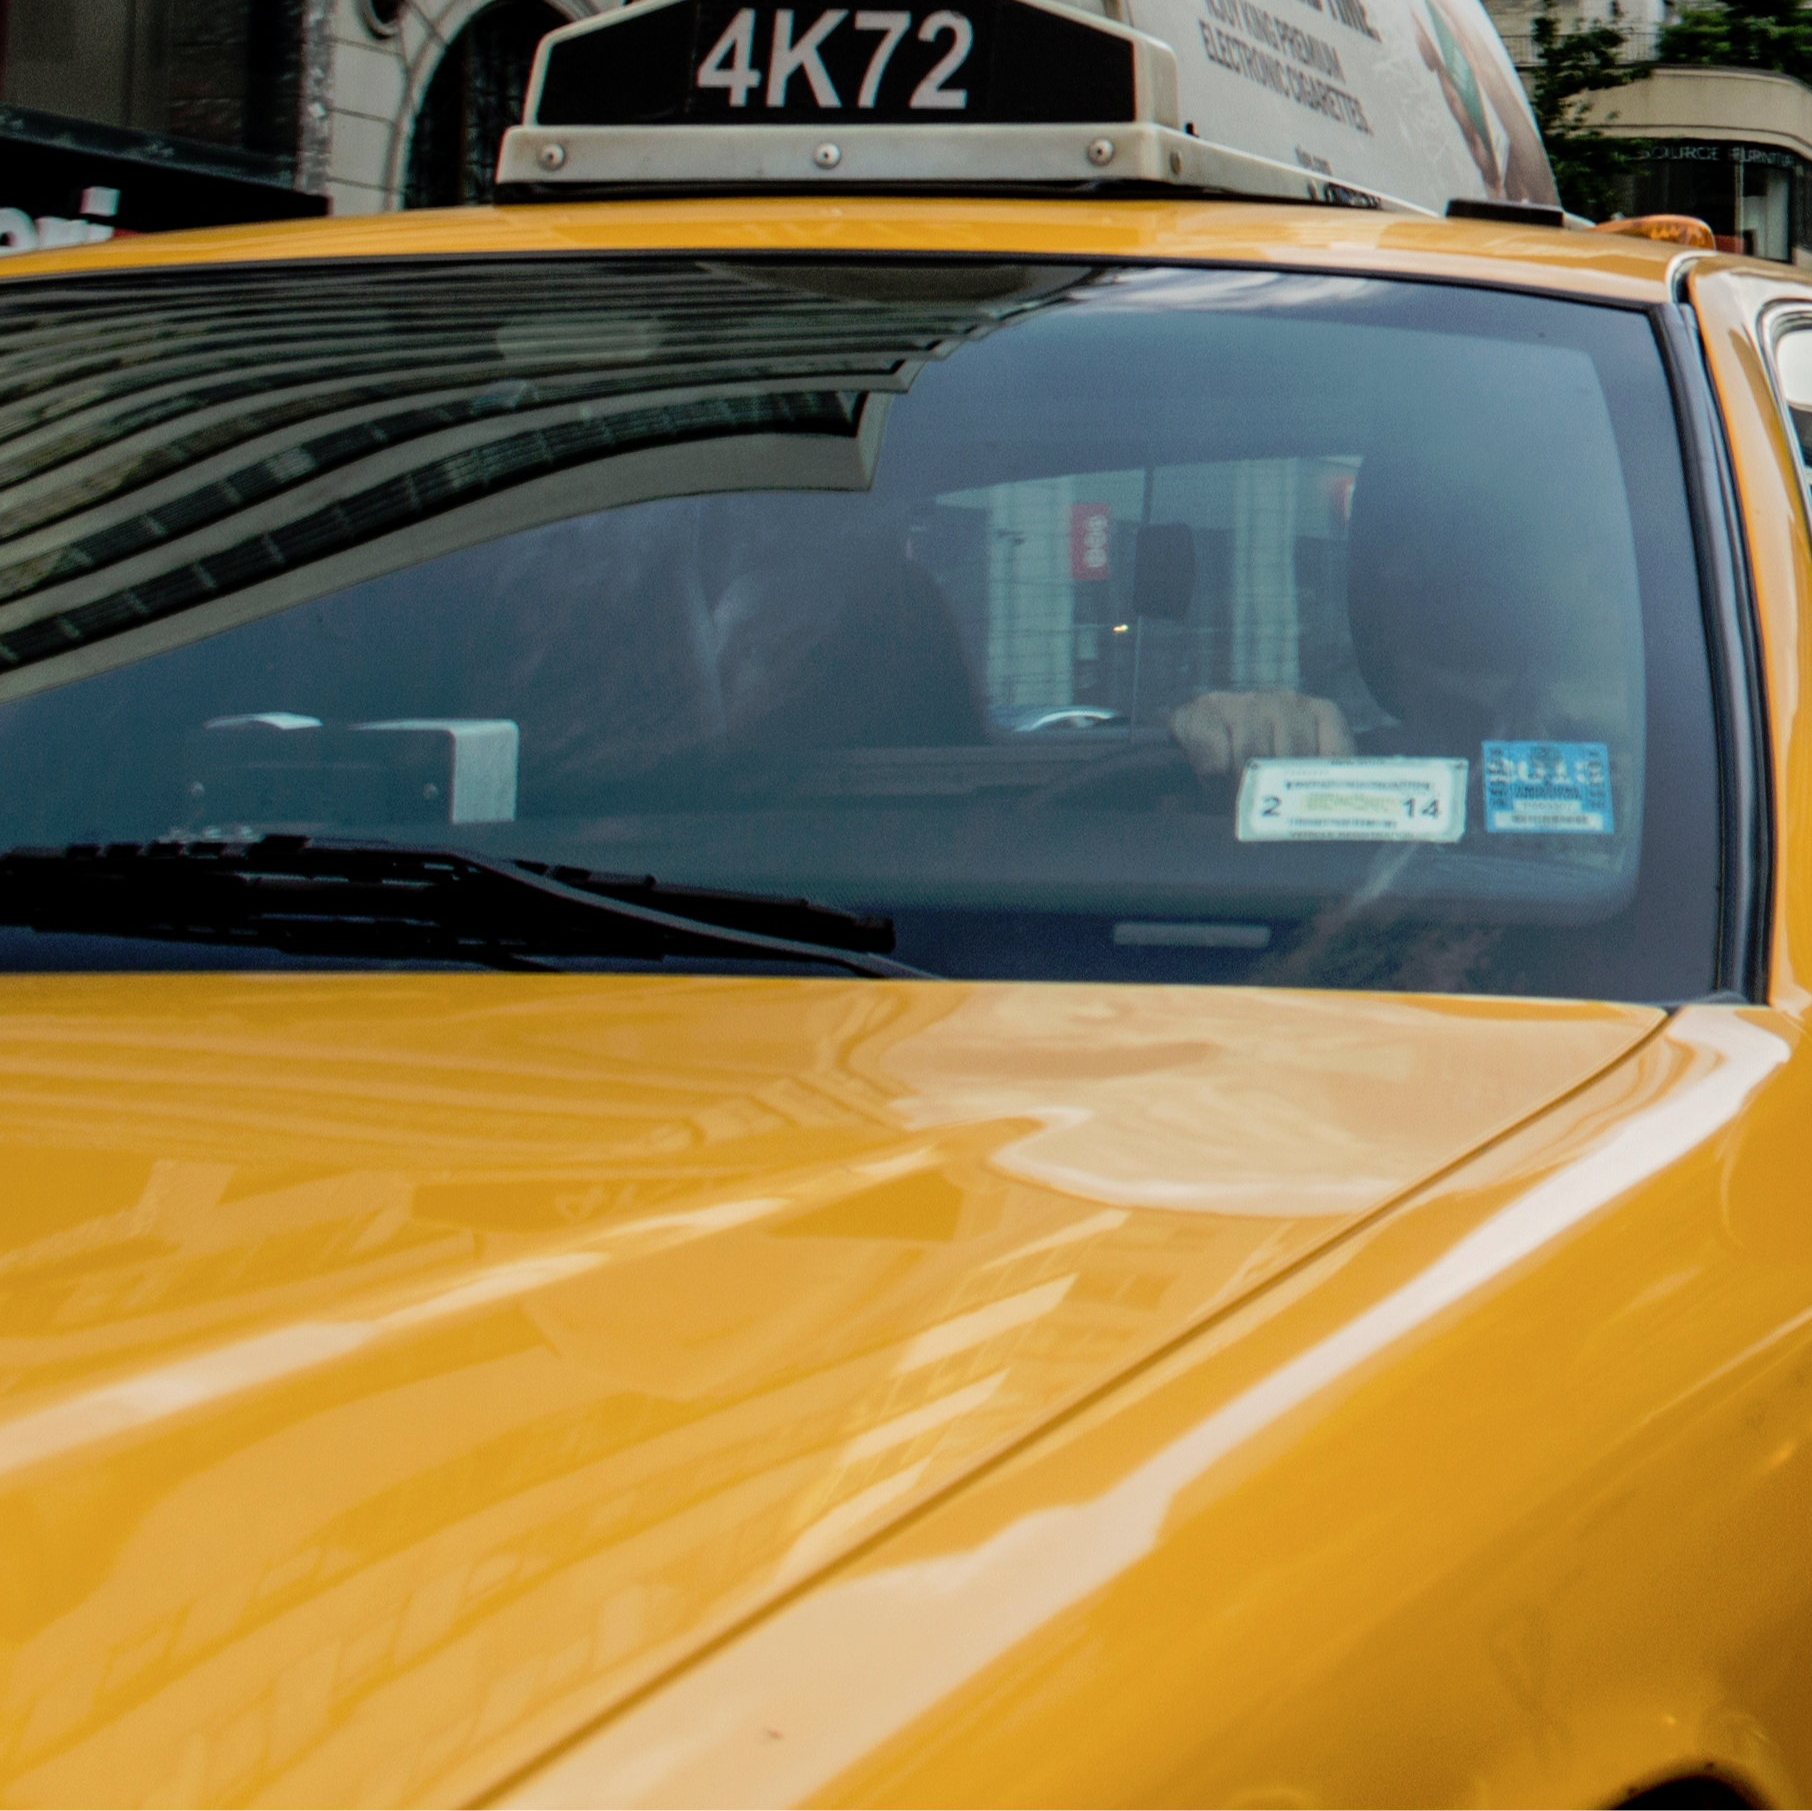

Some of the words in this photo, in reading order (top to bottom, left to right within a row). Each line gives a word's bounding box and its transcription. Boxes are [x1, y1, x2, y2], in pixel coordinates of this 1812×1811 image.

[696, 9, 973, 109] 4K72
[1197, 17, 1291, 99] ELECTRONIC
[1273, 16, 1347, 85] PREMIUM
[1261, 795, 1283, 818] 2
[1402, 797, 1442, 819] 14
